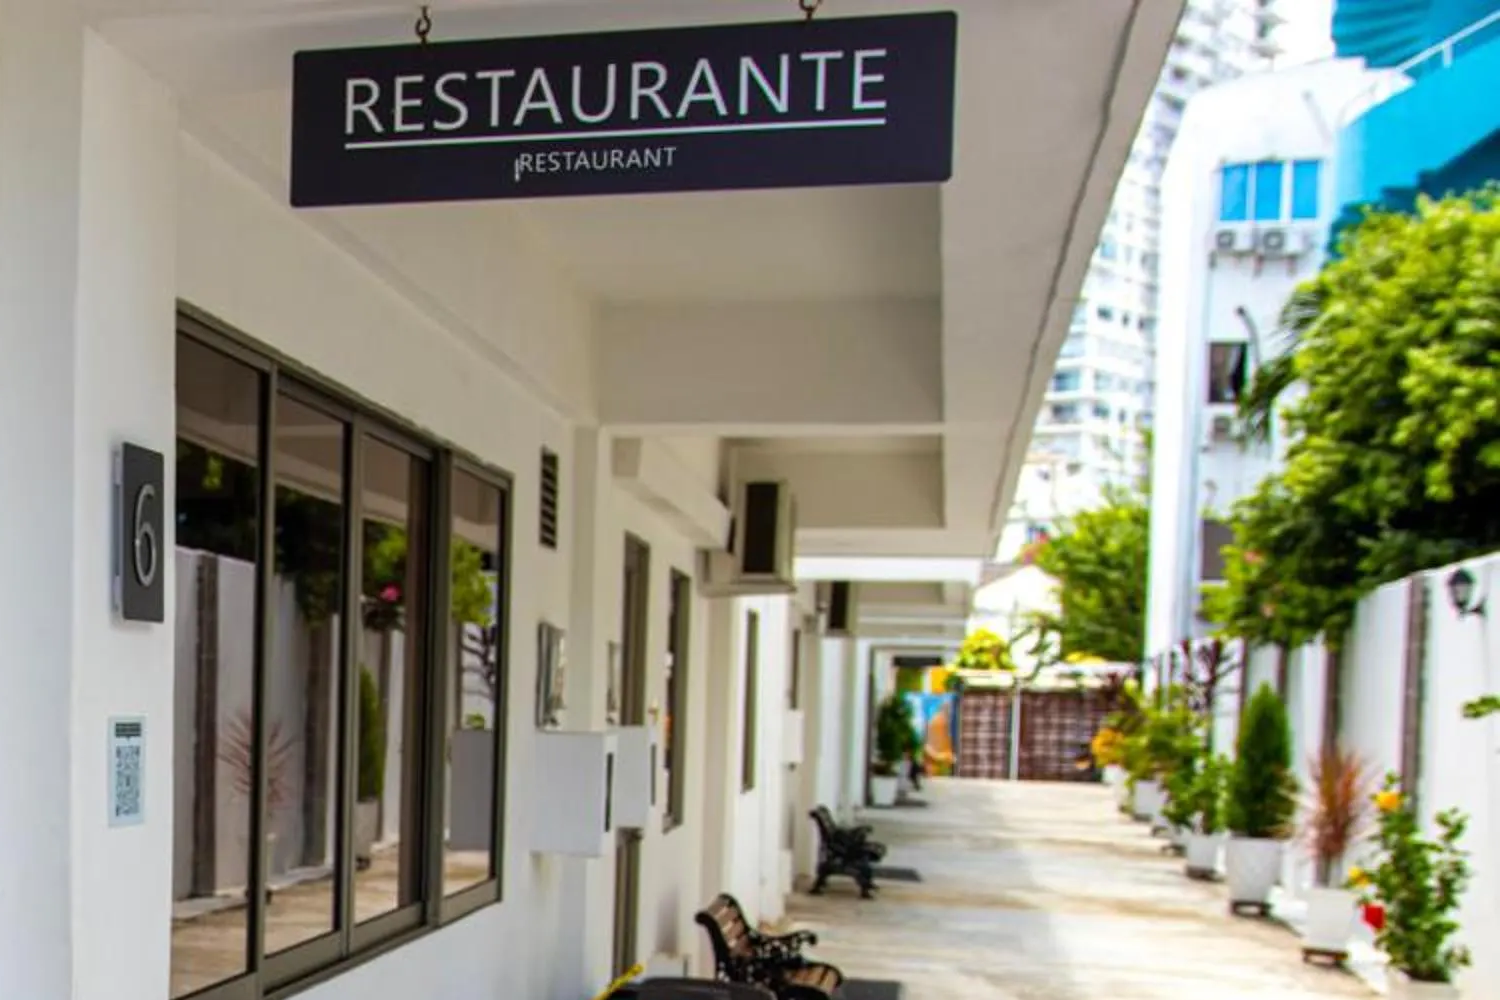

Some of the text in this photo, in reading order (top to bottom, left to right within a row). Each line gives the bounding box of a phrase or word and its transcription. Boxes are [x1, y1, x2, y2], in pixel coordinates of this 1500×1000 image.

[344, 49, 887, 135] RESTAURANTE
[518, 146, 677, 173] RESTAURANT
[134, 483, 157, 587] 6
